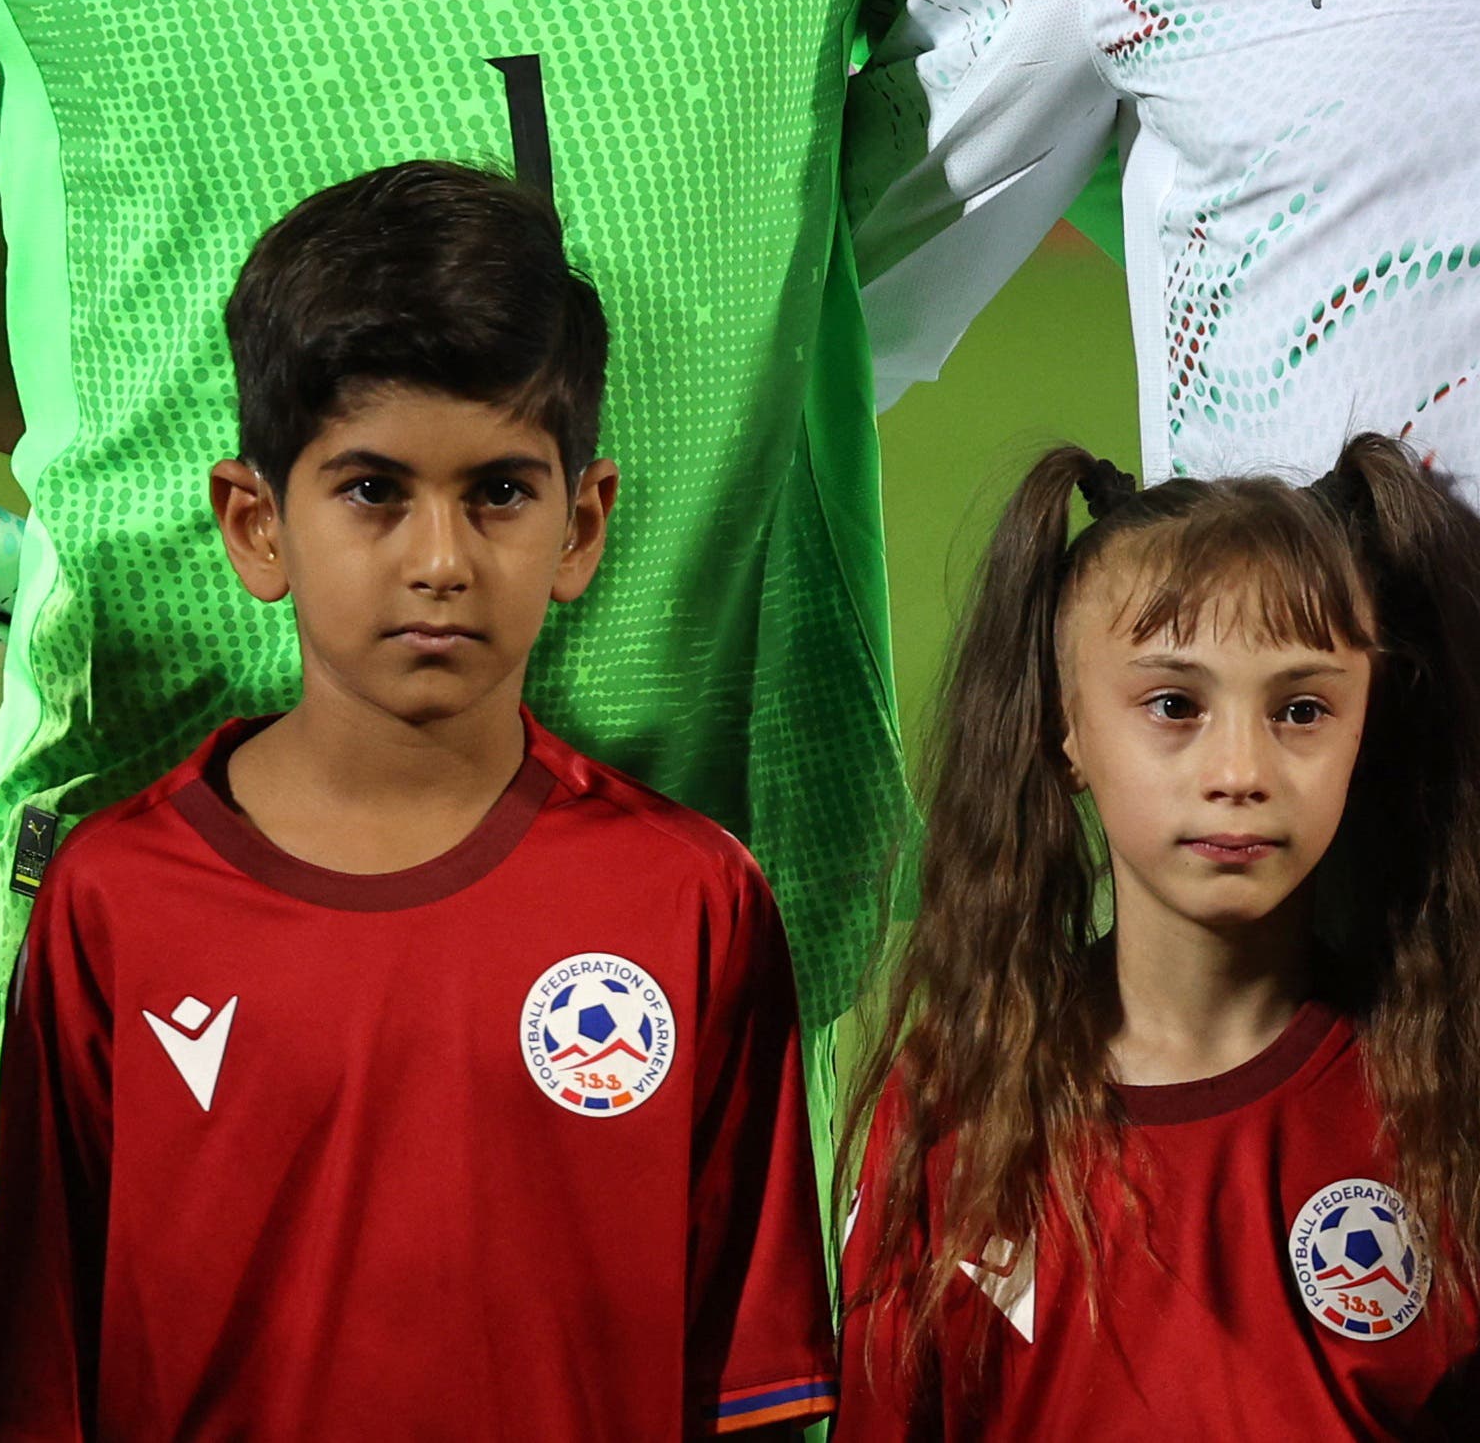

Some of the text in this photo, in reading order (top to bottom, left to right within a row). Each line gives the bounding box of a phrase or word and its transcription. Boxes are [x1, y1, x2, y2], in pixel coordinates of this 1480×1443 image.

[528, 960, 669, 1094] FOOTBALL FEDERATION OF ARMENIA
[1295, 1218, 1324, 1308] FOOTBALL
